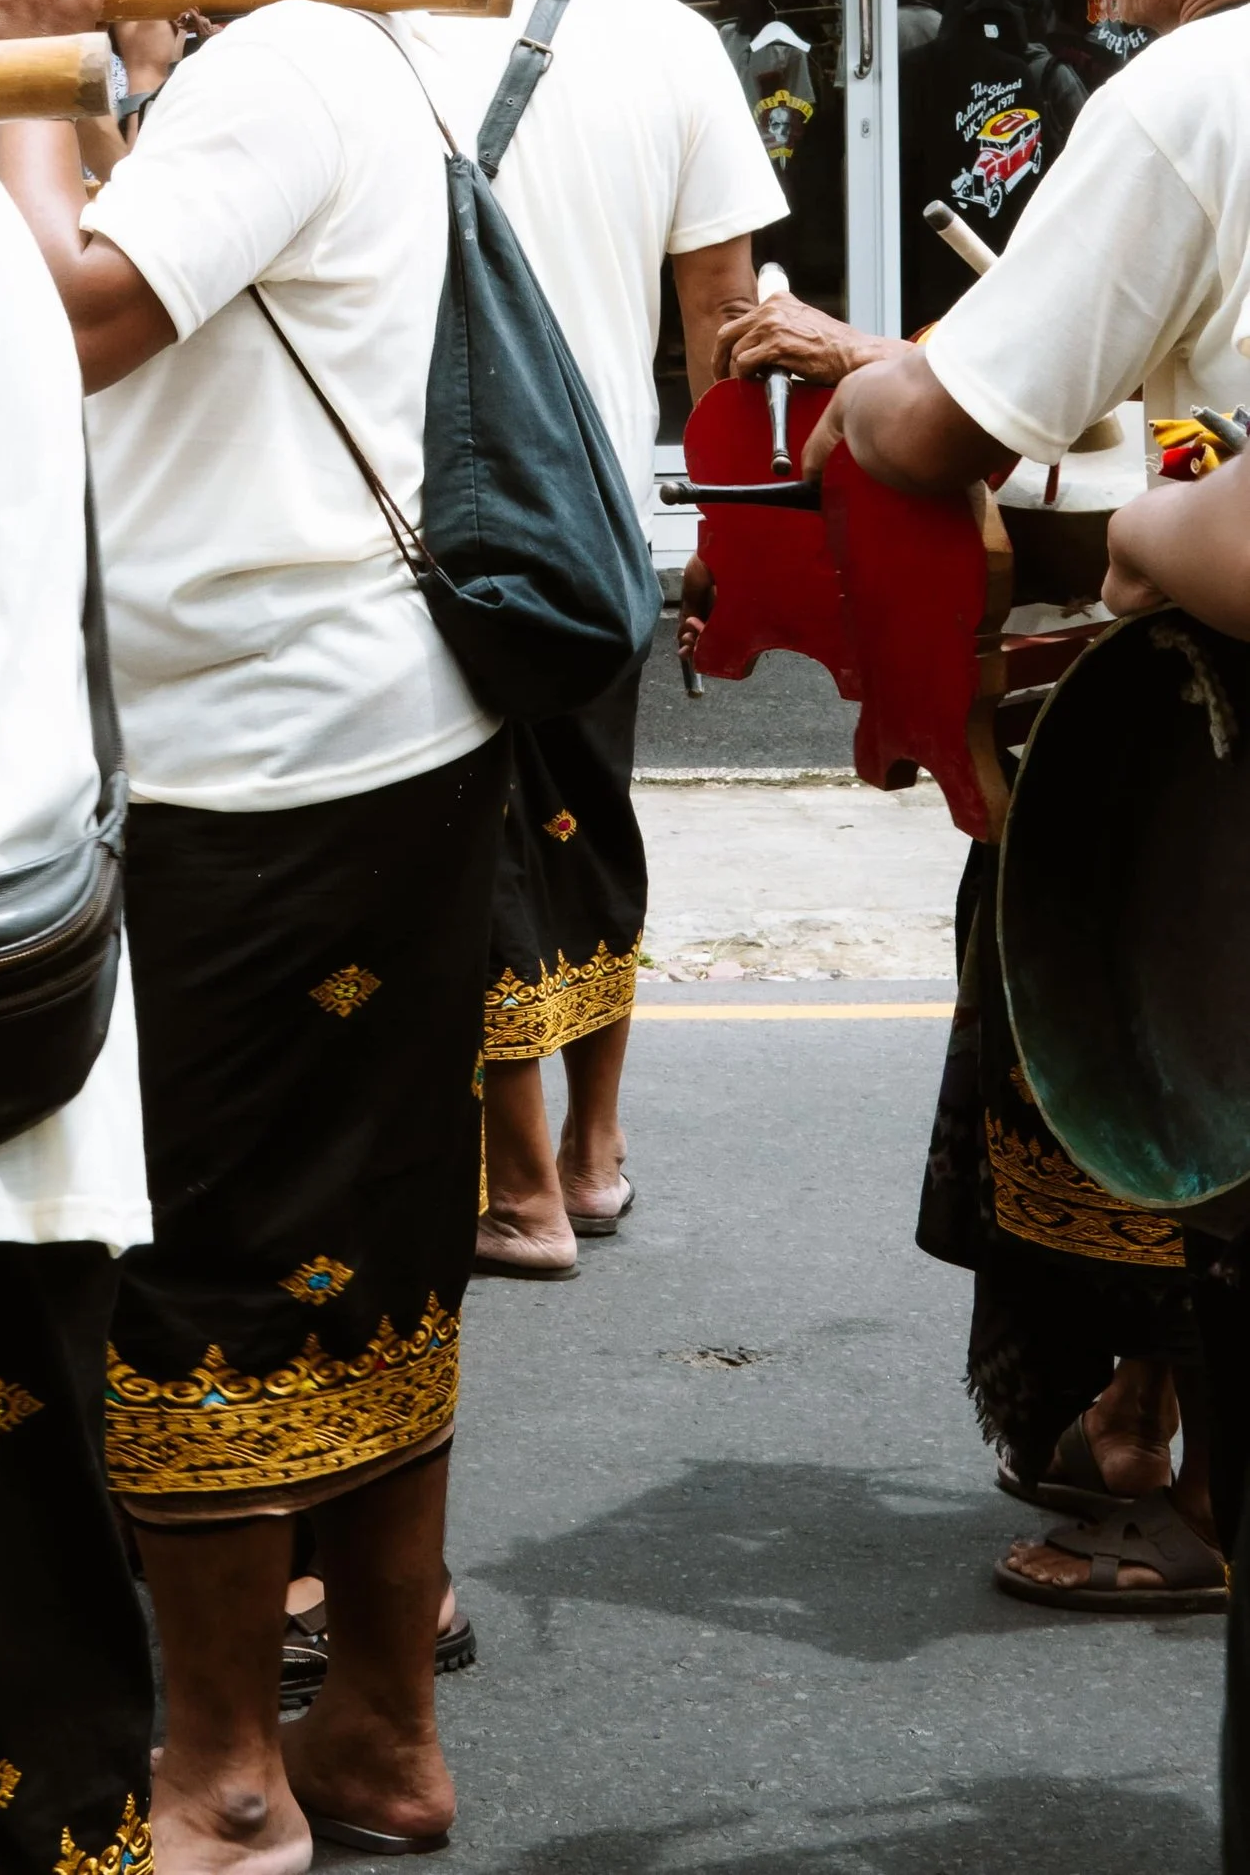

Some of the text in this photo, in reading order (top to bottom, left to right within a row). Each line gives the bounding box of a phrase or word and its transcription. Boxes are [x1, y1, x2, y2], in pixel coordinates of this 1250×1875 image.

[955, 78, 1022, 131] Rolling Stones
[970, 82, 989, 99] The
[963, 119, 980, 142] UK
[996, 92, 1015, 111] 1971
